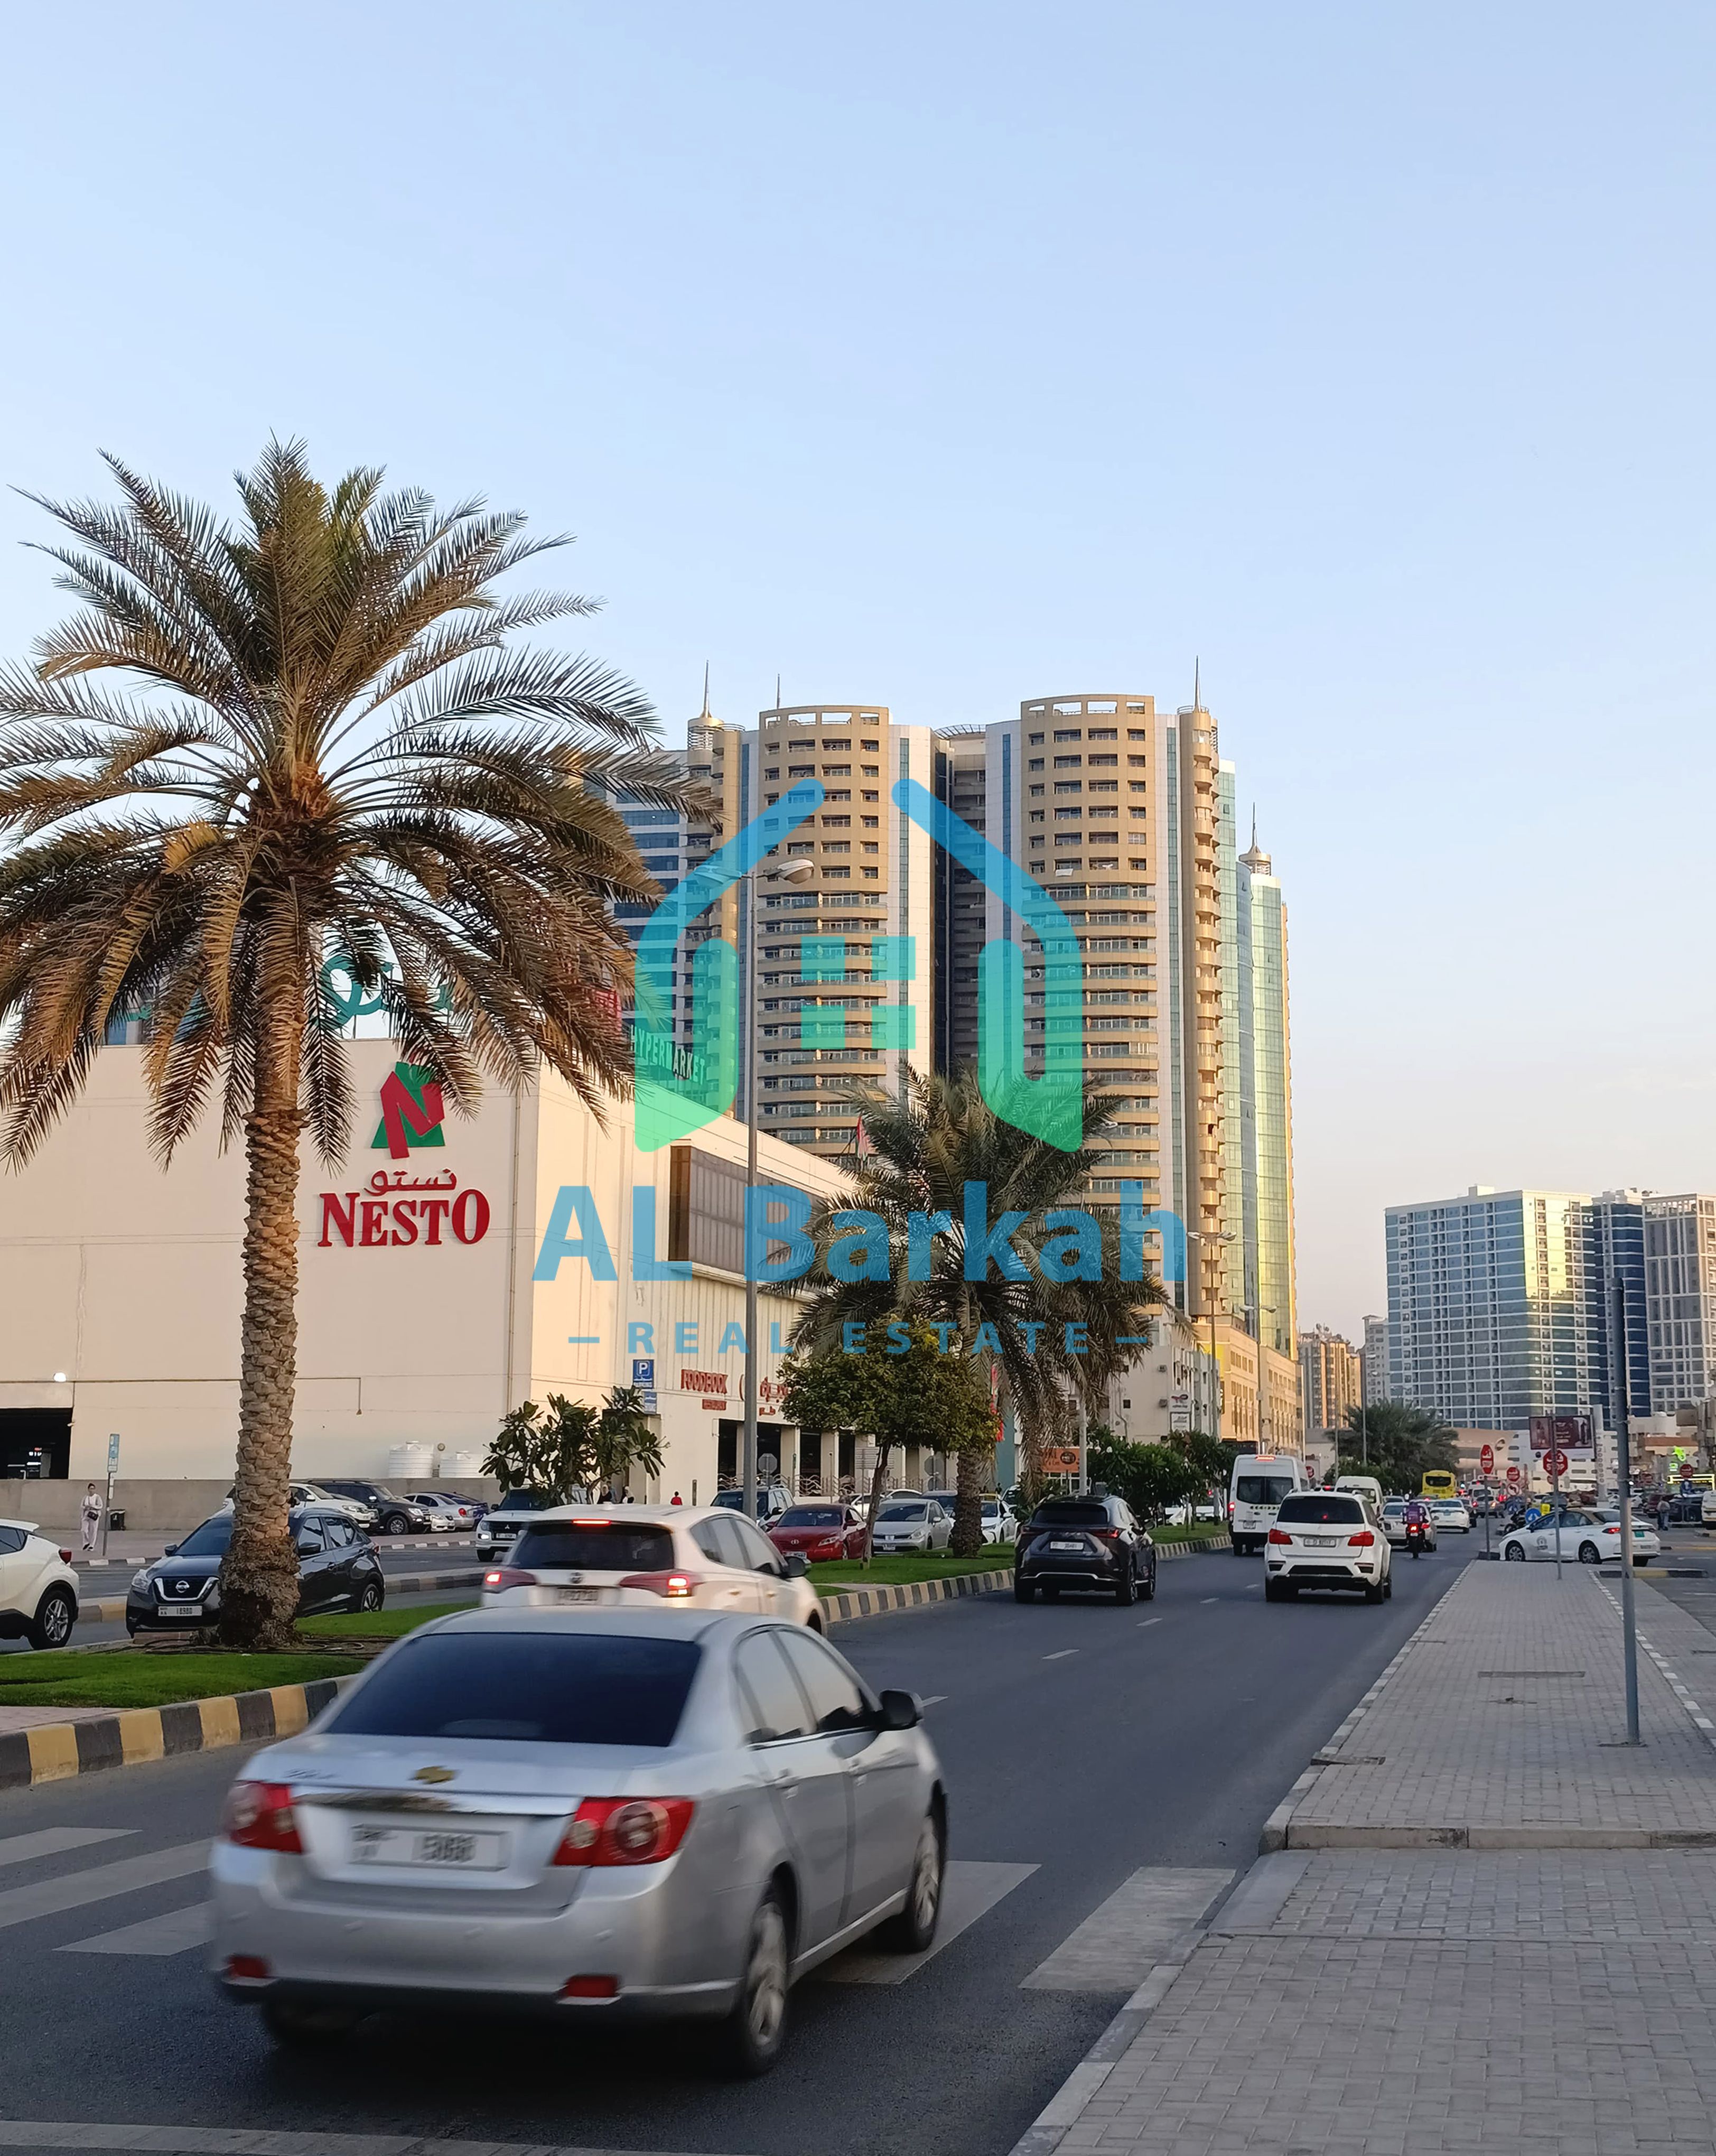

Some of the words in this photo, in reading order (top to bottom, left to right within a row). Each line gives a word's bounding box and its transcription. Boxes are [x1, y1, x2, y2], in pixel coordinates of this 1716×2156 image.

[364, 1168, 457, 1196] نستو
[318, 1189, 490, 1247] NESTO
[639, 1362, 648, 1374] P
[1546, 1463, 1565, 1471] SOP
